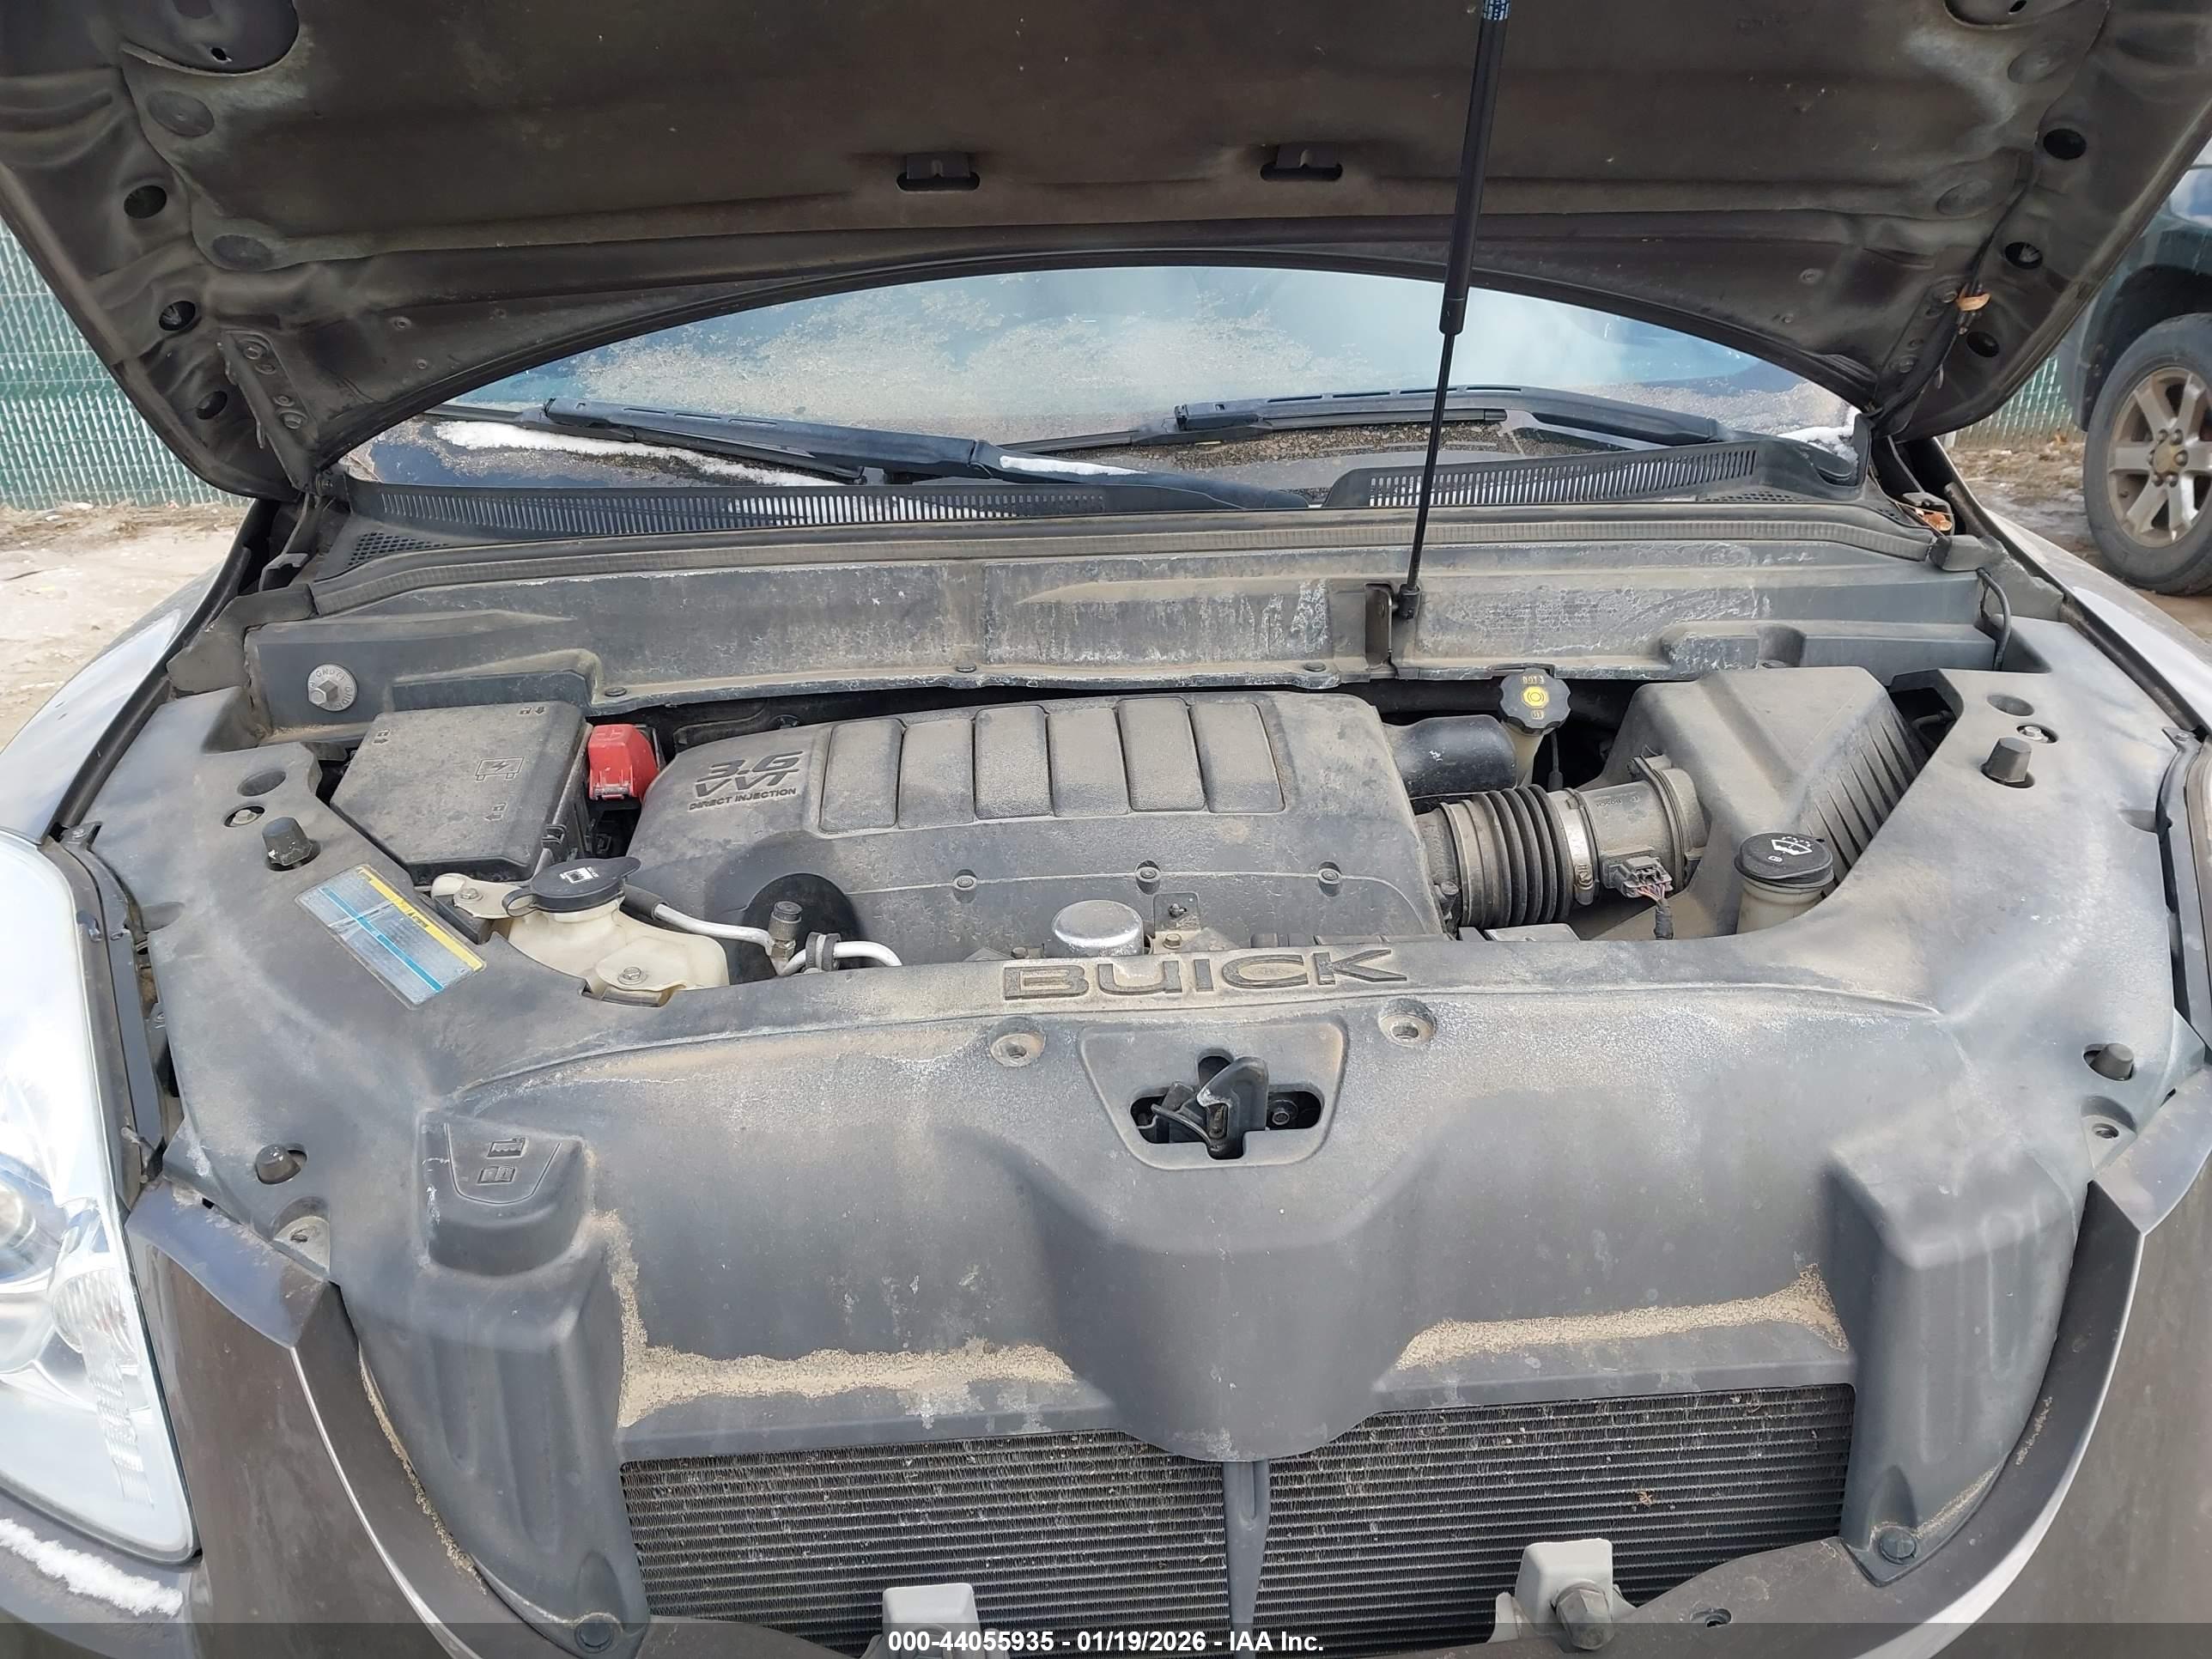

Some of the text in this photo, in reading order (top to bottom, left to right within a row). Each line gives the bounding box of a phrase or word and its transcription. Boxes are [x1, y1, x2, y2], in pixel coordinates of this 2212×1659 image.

[696, 750, 804, 782] 3.6
[695, 769, 800, 798] VVT
[689, 787, 796, 811] DIRECT INJECTION
[1003, 948, 1407, 1001] BUICK
